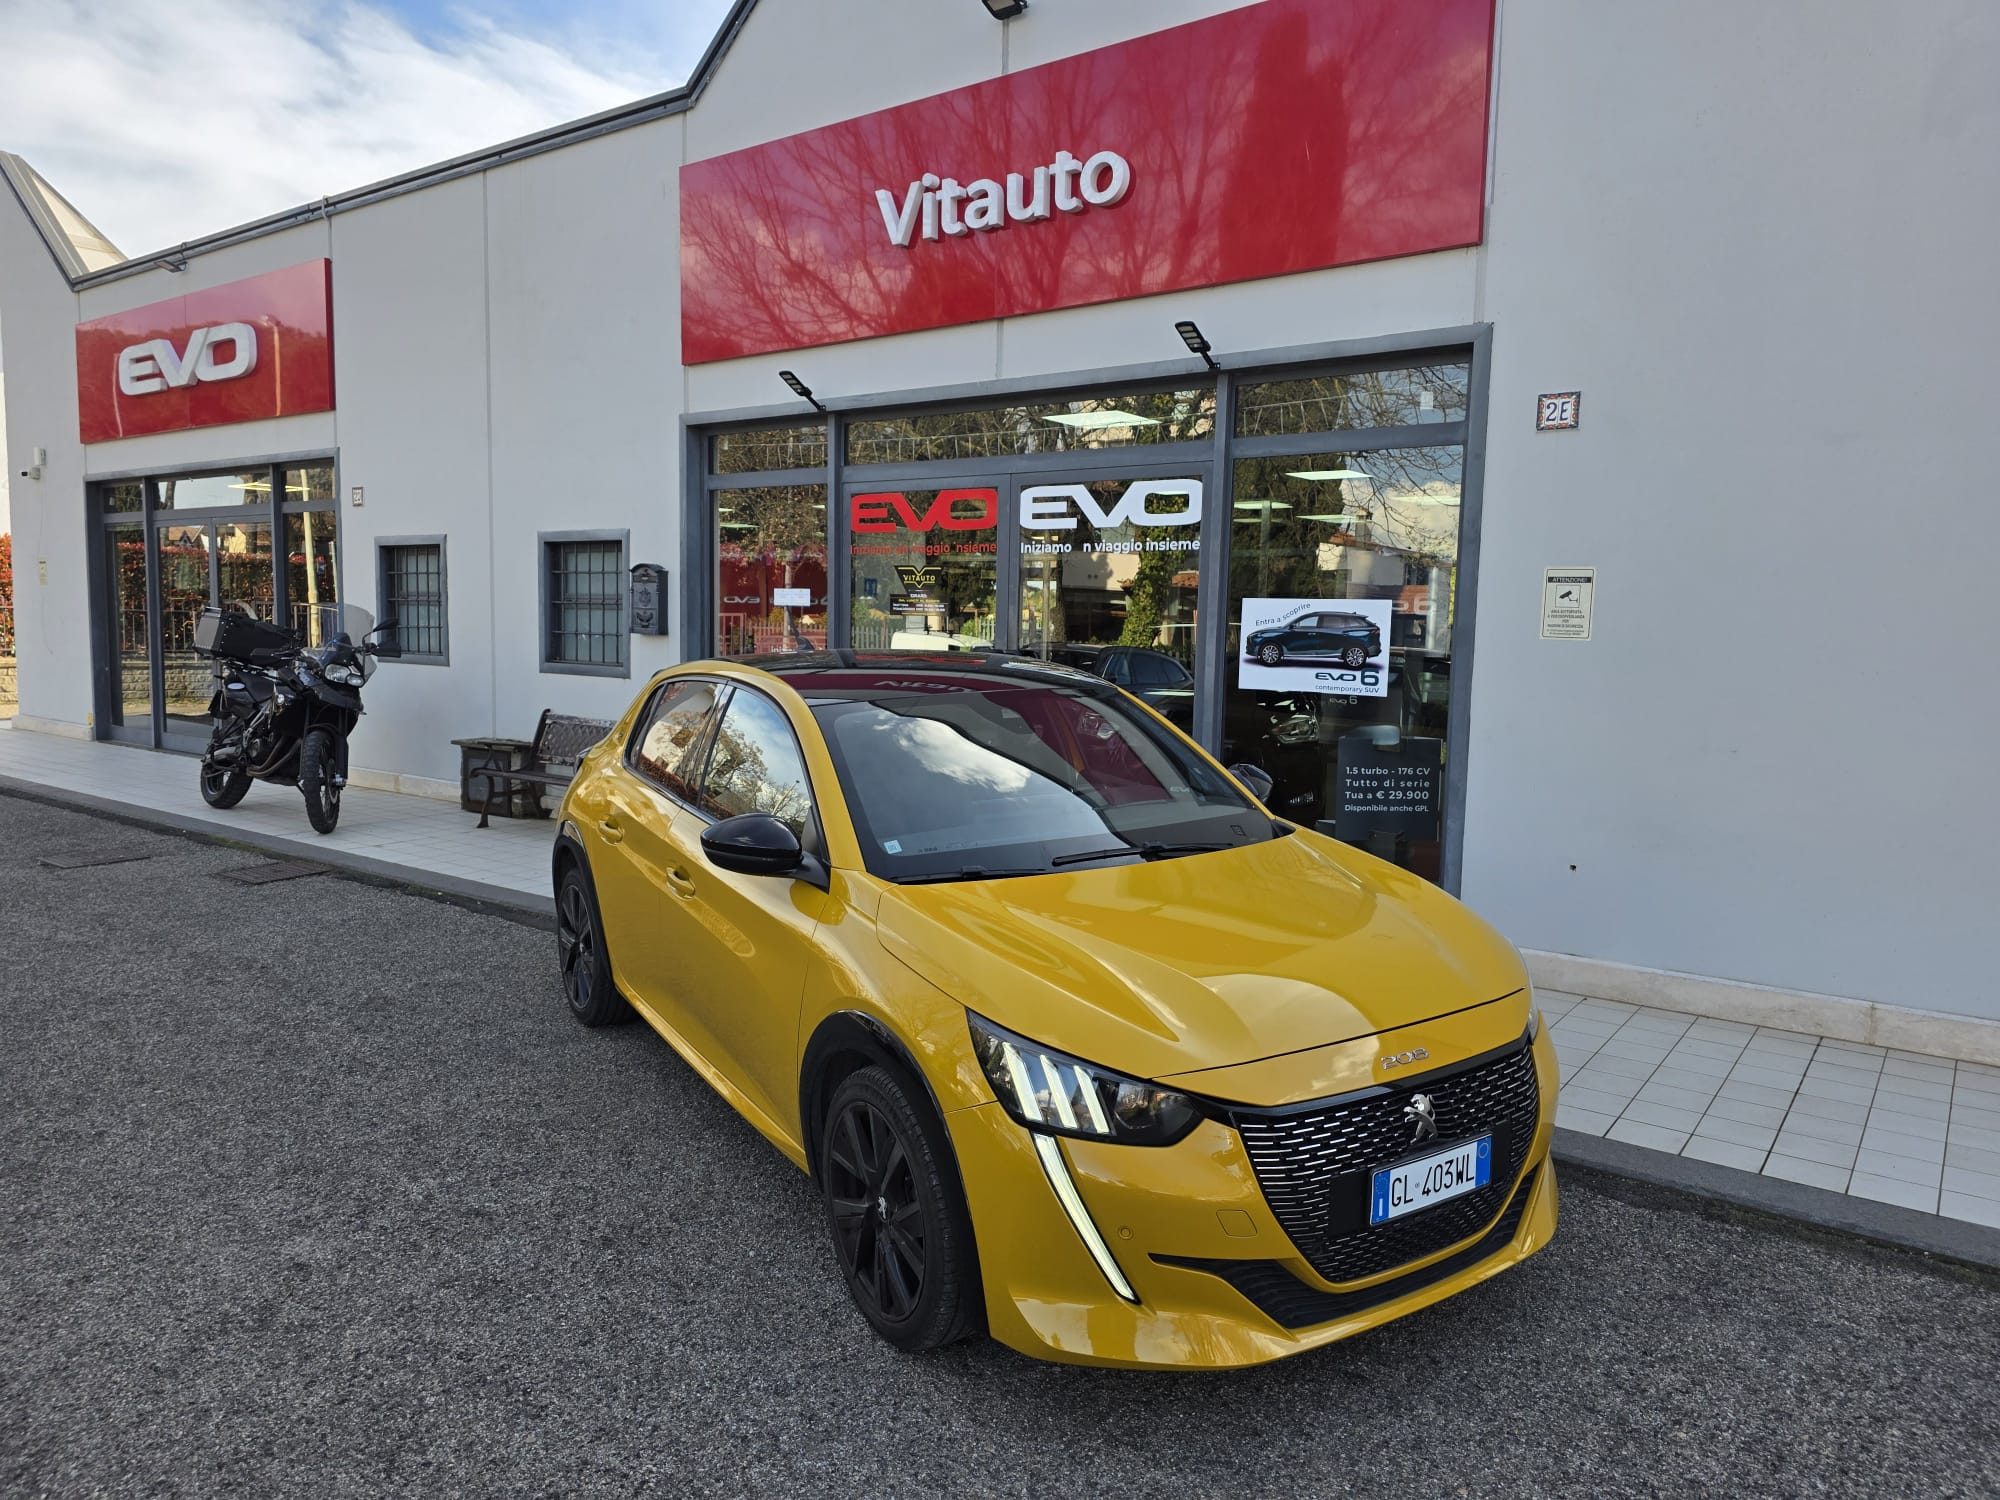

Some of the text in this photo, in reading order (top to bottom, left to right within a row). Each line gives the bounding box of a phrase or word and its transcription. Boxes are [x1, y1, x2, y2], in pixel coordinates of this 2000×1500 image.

[874, 150, 1131, 247] Vitauto
[118, 322, 257, 396] EVO
[1546, 400, 1571, 422] 2E
[850, 488, 998, 533] EVO
[1020, 479, 1203, 530] EVO
[1020, 541, 1072, 554] Iniziamo
[1095, 539, 1143, 555] viaggio
[1146, 537, 1201, 551] insieme
[902, 574, 936, 582] VITAUTO
[1255, 618, 1275, 627] Entra
[1282, 602, 1311, 621] scoprire
[1315, 668, 1380, 687] EVO 6
[1315, 684, 1380, 694] contemporary SUV
[1345, 766, 1359, 775] 1.5
[1361, 766, 1389, 775] turbo
[1398, 767, 1414, 775] 176
[1416, 767, 1431, 775] CV
[1345, 779, 1430, 787] Tutto di serie
[1345, 791, 1364, 799] Tua
[1376, 790, 1385, 800] €
[1388, 790, 1429, 800] 29.900
[1344, 804, 1388, 813] Disponibile
[1389, 804, 1414, 812] anche
[1380, 1047, 1429, 1071] 208
